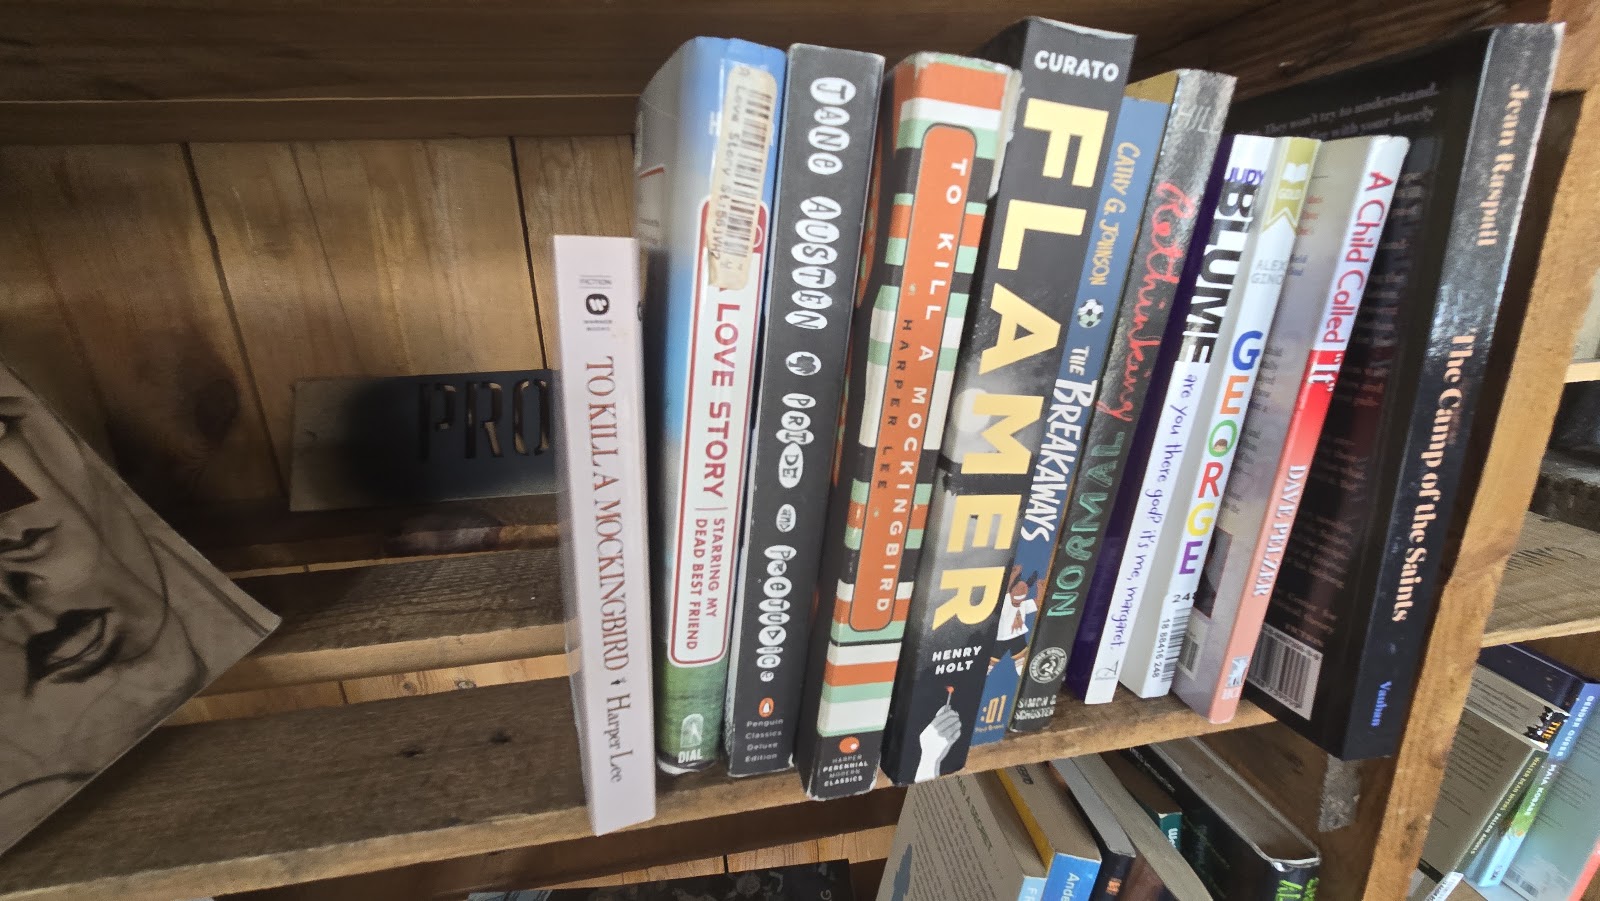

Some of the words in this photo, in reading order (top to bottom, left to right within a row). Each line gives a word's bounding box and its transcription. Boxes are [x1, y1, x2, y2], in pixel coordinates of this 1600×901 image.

[1034, 50, 1119, 82] CURATO
[945, 157, 969, 205] TO
[1227, 167, 1264, 185] JUDY
[1365, 172, 1394, 192] A
[1088, 218, 1119, 286] JOHNSON
[1346, 199, 1385, 264] Child
[791, 197, 839, 329] AUSTEN
[925, 232, 955, 321] KILL
[1178, 180, 1258, 363] BLUME
[1096, 181, 1196, 422] Rethinking
[1322, 270, 1365, 344] Called
[711, 303, 741, 387] LOVE
[917, 345, 935, 362] A
[932, 97, 1109, 631] FLAMER
[1069, 345, 1090, 376] THE
[1444, 327, 1478, 383] The
[585, 355, 616, 396] TO
[887, 318, 913, 426] HARPER
[1180, 373, 1198, 399] are
[589, 402, 618, 467] KILL
[779, 394, 813, 486] PRIDE
[1169, 404, 1188, 436] you
[1420, 388, 1463, 468] Camp
[703, 401, 732, 498] STORY
[877, 446, 894, 489] LEE
[1020, 379, 1098, 543] BREAKAWAYS
[1156, 443, 1182, 483] there
[1179, 330, 1264, 575] GEORGE
[592, 473, 621, 491] A
[876, 387, 928, 612] MOCKINGBIRD
[1275, 465, 1306, 518] DAVE
[1418, 472, 1442, 502] of
[693, 518, 708, 559] DEAD
[1047, 431, 1126, 617] NORMAL
[1408, 504, 1438, 544] the
[707, 517, 726, 592] STARRING
[1253, 524, 1287, 597] PELZER
[594, 499, 630, 672] MOCKINGBIRD
[690, 563, 703, 597] BEST
[1391, 547, 1427, 622] Saints
[687, 601, 703, 651] FRIEND
[705, 597, 718, 618] MY
[931, 645, 982, 662] HENRY
[934, 660, 974, 675] HOLT
[603, 693, 632, 752] Harper
[746, 717, 784, 728] Penguin
[1017, 697, 1049, 709] SIMON
[1541, 721, 1562, 739] THE
[608, 749, 634, 784] Lee
[678, 749, 704, 765] DIAL
[744, 753, 778, 763] Edition
[822, 760, 869, 773] PERENNIAL
[831, 754, 863, 764] HARPER
[823, 775, 863, 787] CLASSICS
